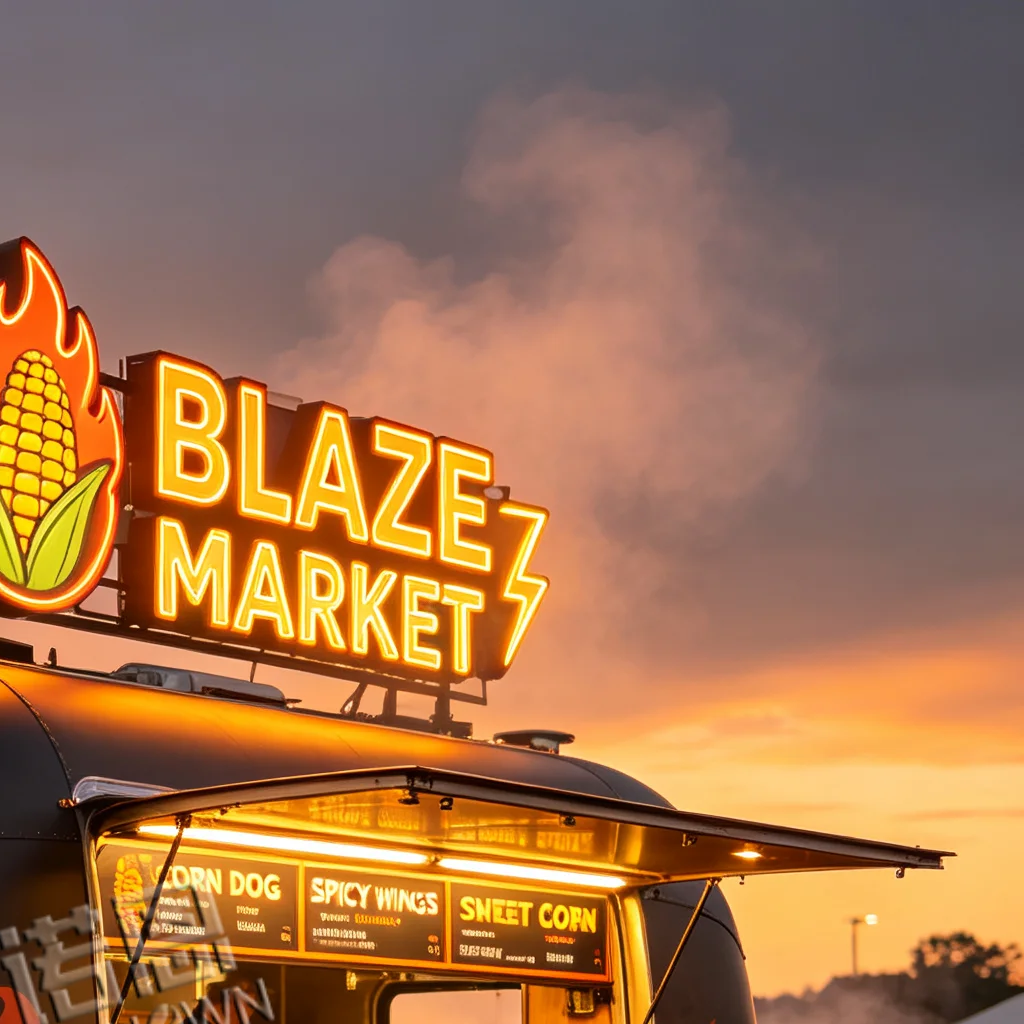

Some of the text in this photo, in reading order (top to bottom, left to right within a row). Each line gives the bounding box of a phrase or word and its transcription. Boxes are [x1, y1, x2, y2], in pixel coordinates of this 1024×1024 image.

[155, 357, 494, 573] BLAZE
[154, 516, 485, 676] MARKET
[155, 865, 282, 901] CORN DOG
[310, 877, 439, 916] SPICY WINGS
